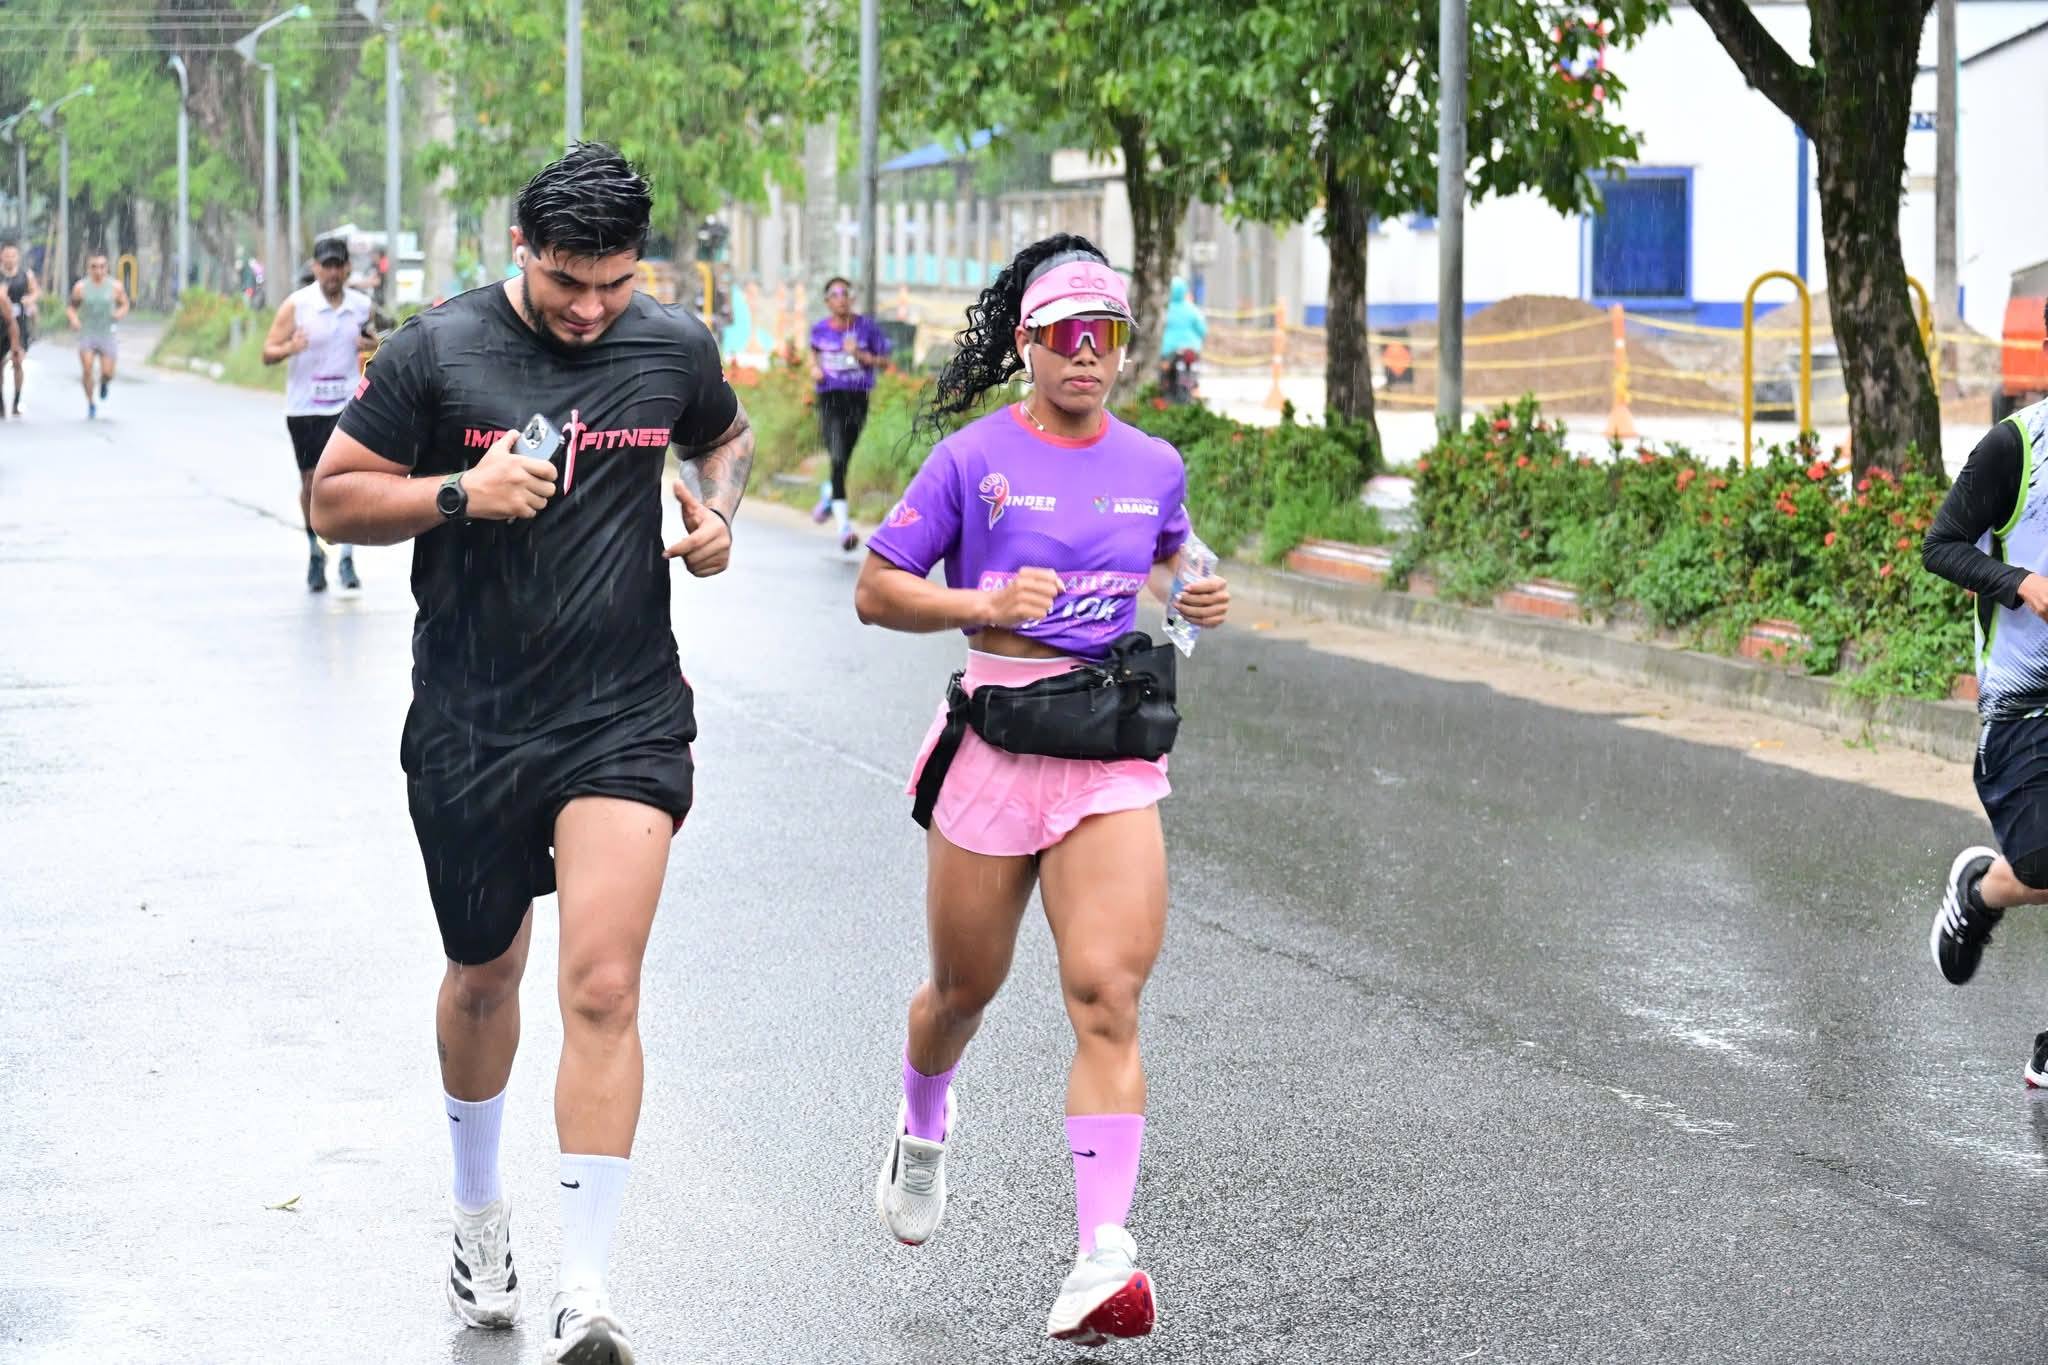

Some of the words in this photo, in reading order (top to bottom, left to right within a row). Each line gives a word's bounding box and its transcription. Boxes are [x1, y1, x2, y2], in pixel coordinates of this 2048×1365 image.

[579, 428, 671, 451] FITNESS
[1005, 495, 1057, 507] INDER
[1113, 503, 1159, 516] ARAUCA
